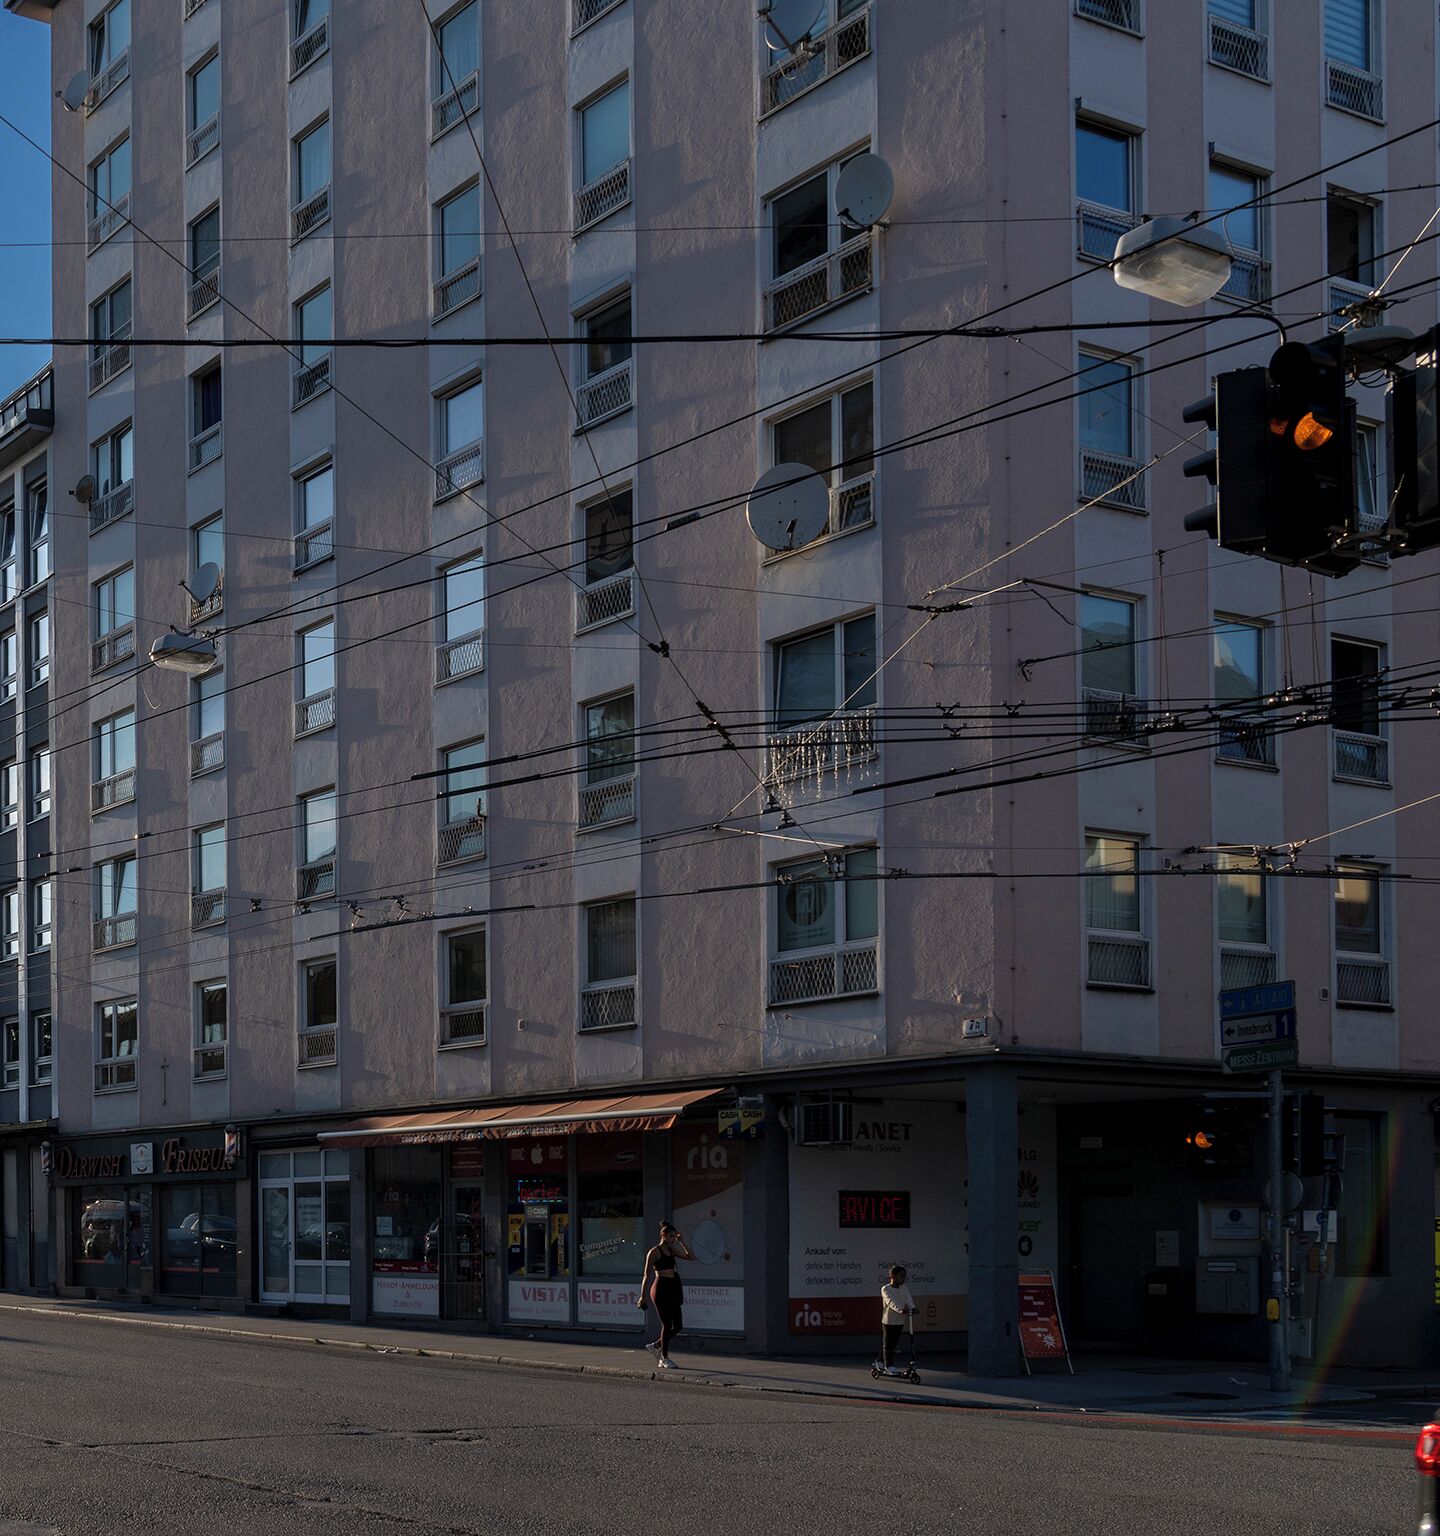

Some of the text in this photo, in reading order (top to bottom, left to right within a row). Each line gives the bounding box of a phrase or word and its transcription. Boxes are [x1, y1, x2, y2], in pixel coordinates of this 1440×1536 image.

[1237, 1014, 1289, 1037] Innsbruck 1
[720, 1111, 739, 1119] CASH
[162, 1136, 234, 1174] FRISEUR
[511, 1147, 526, 1161] MAC
[549, 1145, 565, 1160] MAC
[687, 1133, 728, 1169] ria
[1024, 1150, 1037, 1161] LG
[58, 1146, 122, 1179] DARWISH
[510, 1218, 522, 1226] ATM
[580, 1236, 624, 1253] Computer
[805, 1246, 847, 1256] Ankauf von:
[805, 1261, 862, 1272] defekten Handys
[902, 1260, 925, 1269] Service
[805, 1276, 864, 1287] defekten Laptops
[912, 1275, 936, 1284] Service
[521, 1286, 569, 1303] VISTA
[579, 1289, 637, 1306] NET.at
[687, 1287, 729, 1296] INTERNET
[795, 1303, 821, 1328] ria
